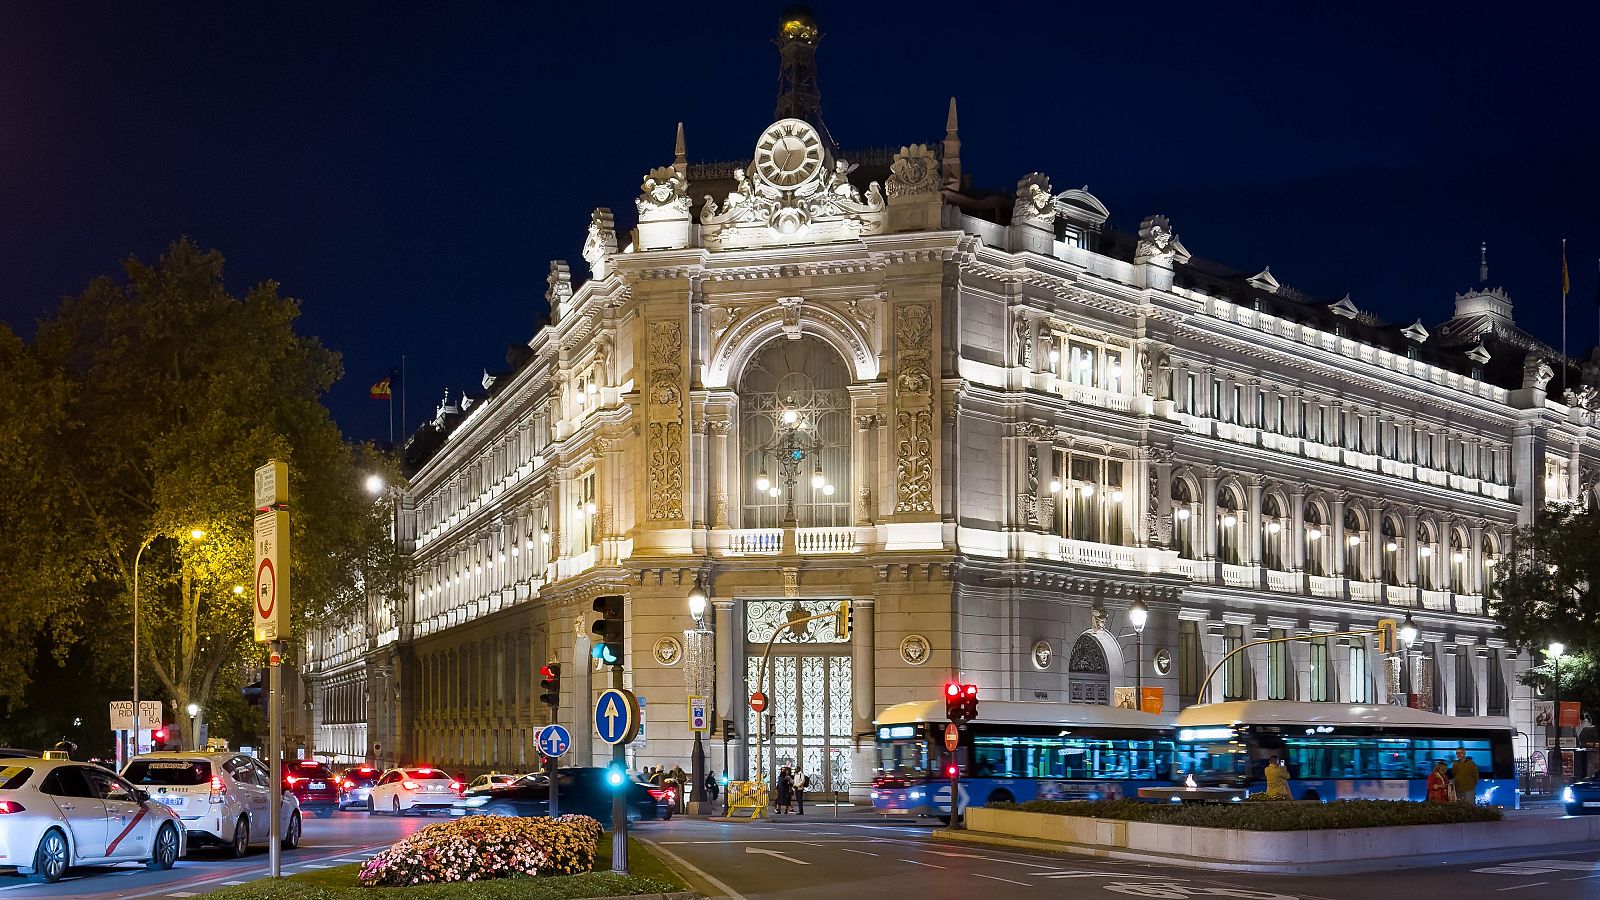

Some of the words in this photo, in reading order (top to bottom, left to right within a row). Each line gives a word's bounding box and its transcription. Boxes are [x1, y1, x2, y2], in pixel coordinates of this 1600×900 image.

[111, 702, 133, 710] MAD
[140, 702, 158, 710] CUL
[143, 709, 155, 717] TU
